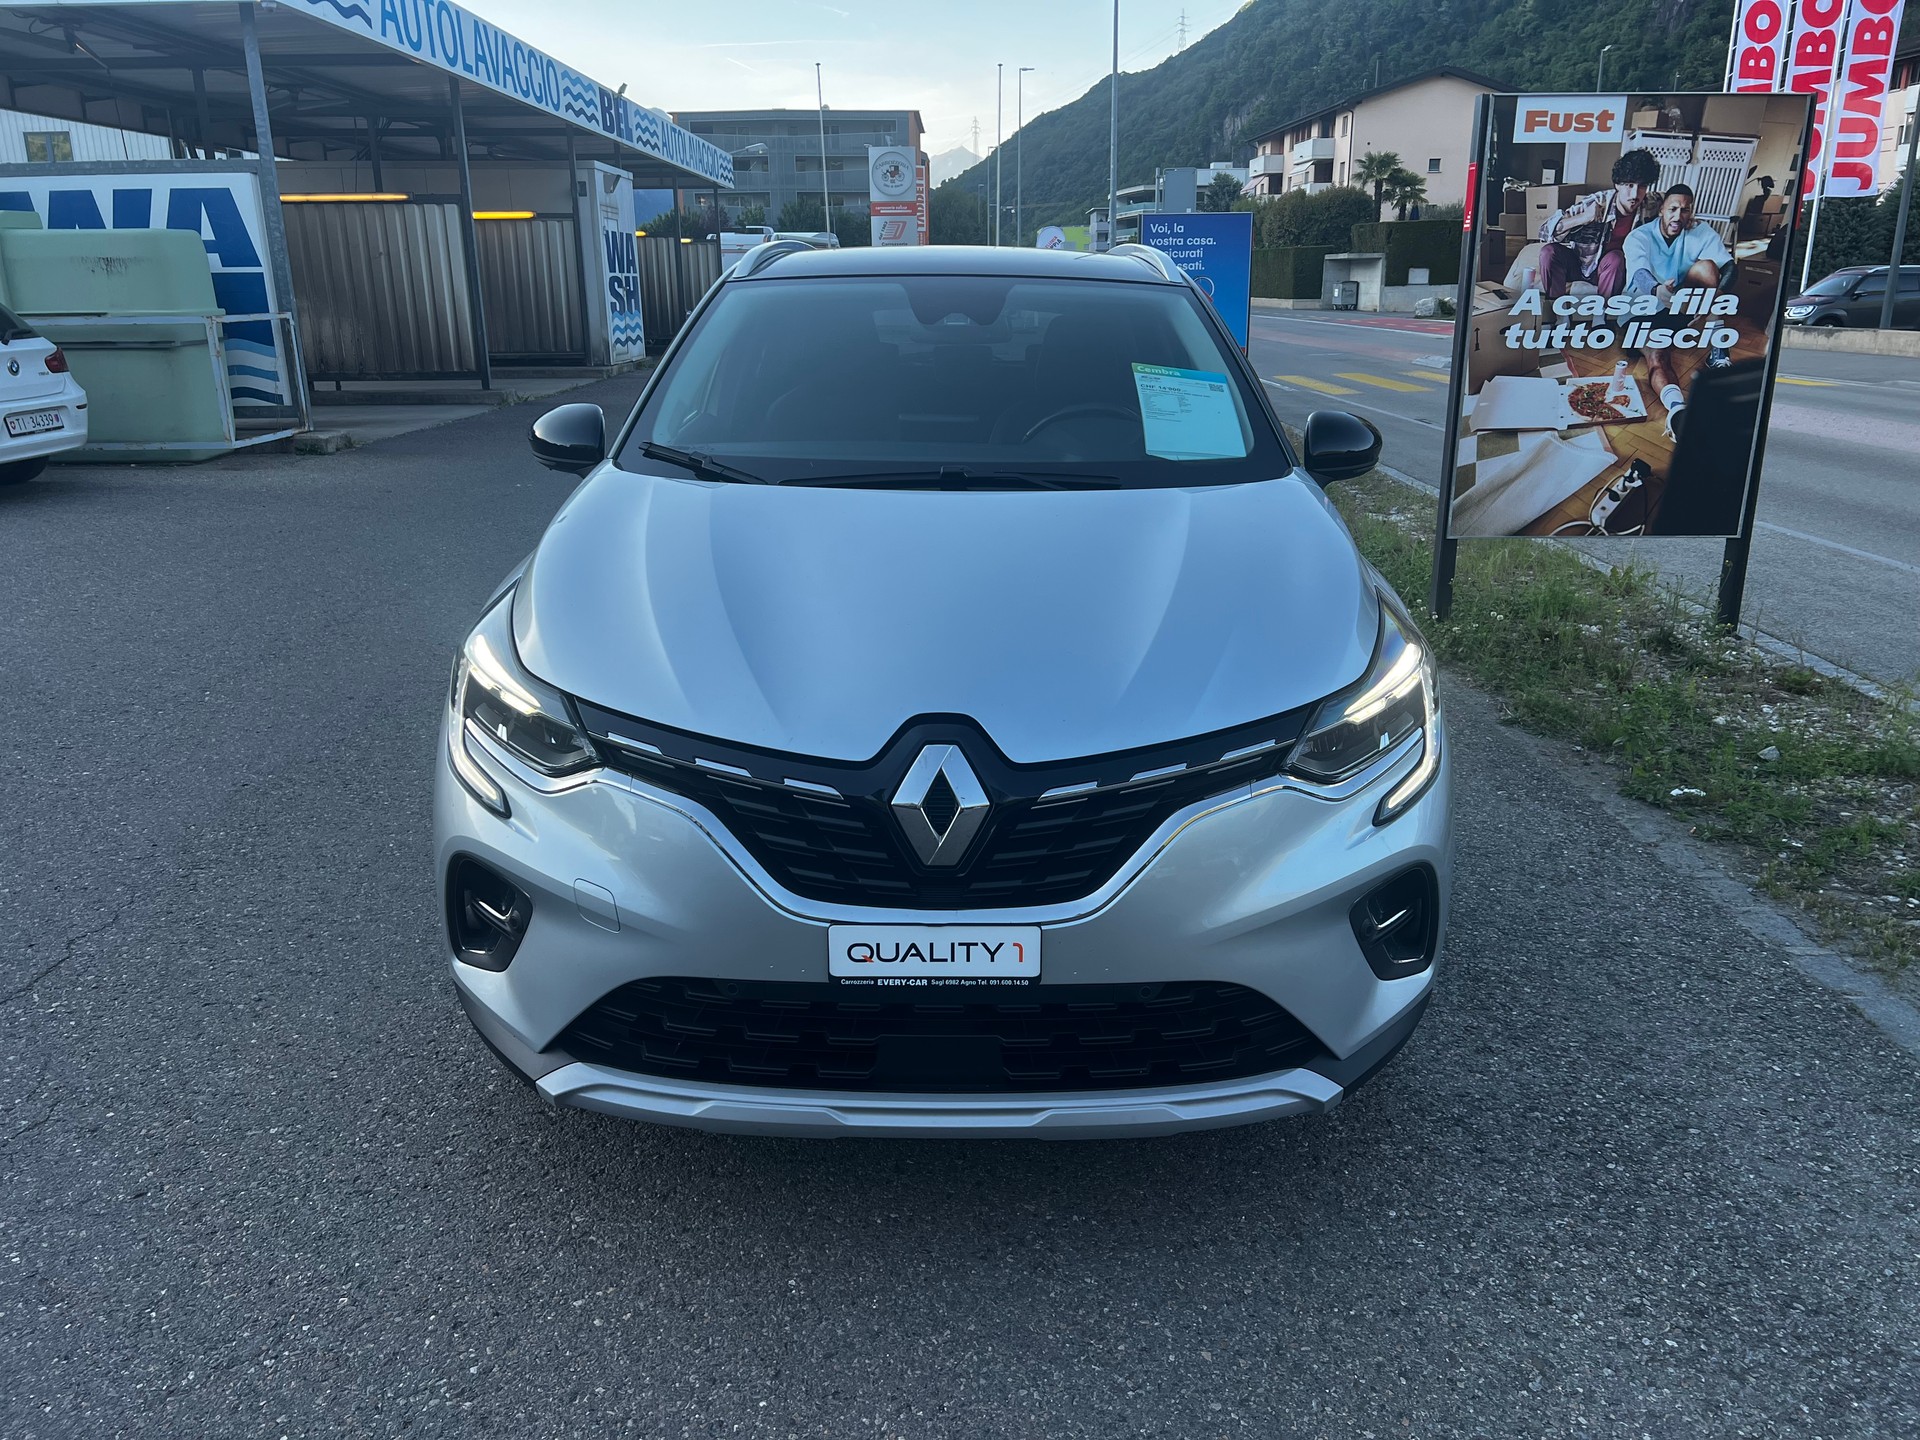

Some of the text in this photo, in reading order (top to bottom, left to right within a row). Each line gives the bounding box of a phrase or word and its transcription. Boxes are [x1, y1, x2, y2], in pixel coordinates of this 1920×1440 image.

[599, 87, 633, 143] BEL
[1524, 109, 1615, 132] Fust
[1150, 223, 1184, 234] Voi, la
[1150, 237, 1216, 245] vostra casa.
[604, 230, 637, 273] WA
[609, 276, 640, 315] SH
[1508, 288, 1739, 316] A casa fila
[1504, 322, 1739, 349] tutto liscio
[1137, 365, 1181, 376] Cembra
